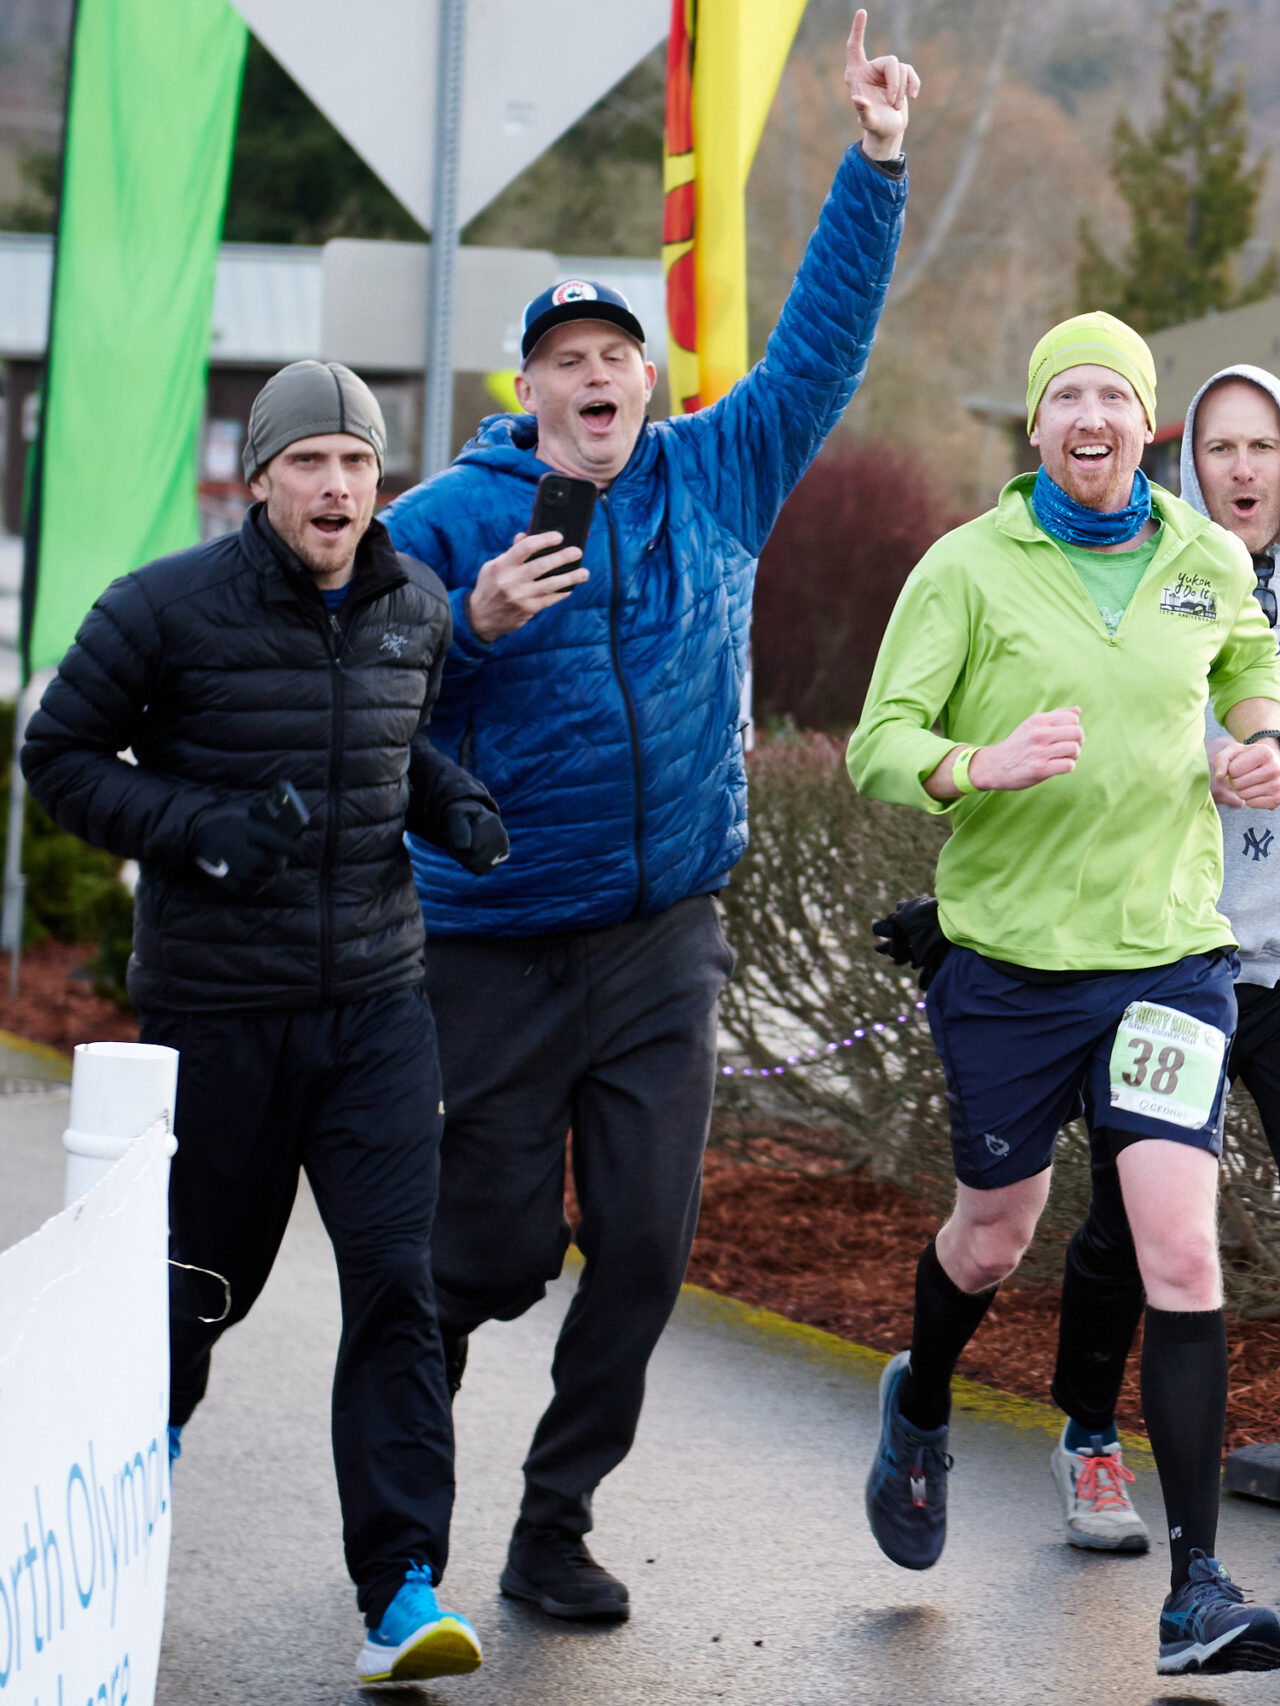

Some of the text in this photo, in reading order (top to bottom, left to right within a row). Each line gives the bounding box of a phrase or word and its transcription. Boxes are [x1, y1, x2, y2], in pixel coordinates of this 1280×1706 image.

[1175, 572, 1212, 594] Yukon
[1183, 584, 1211, 600] Do It
[1121, 1038, 1186, 1095] 38
